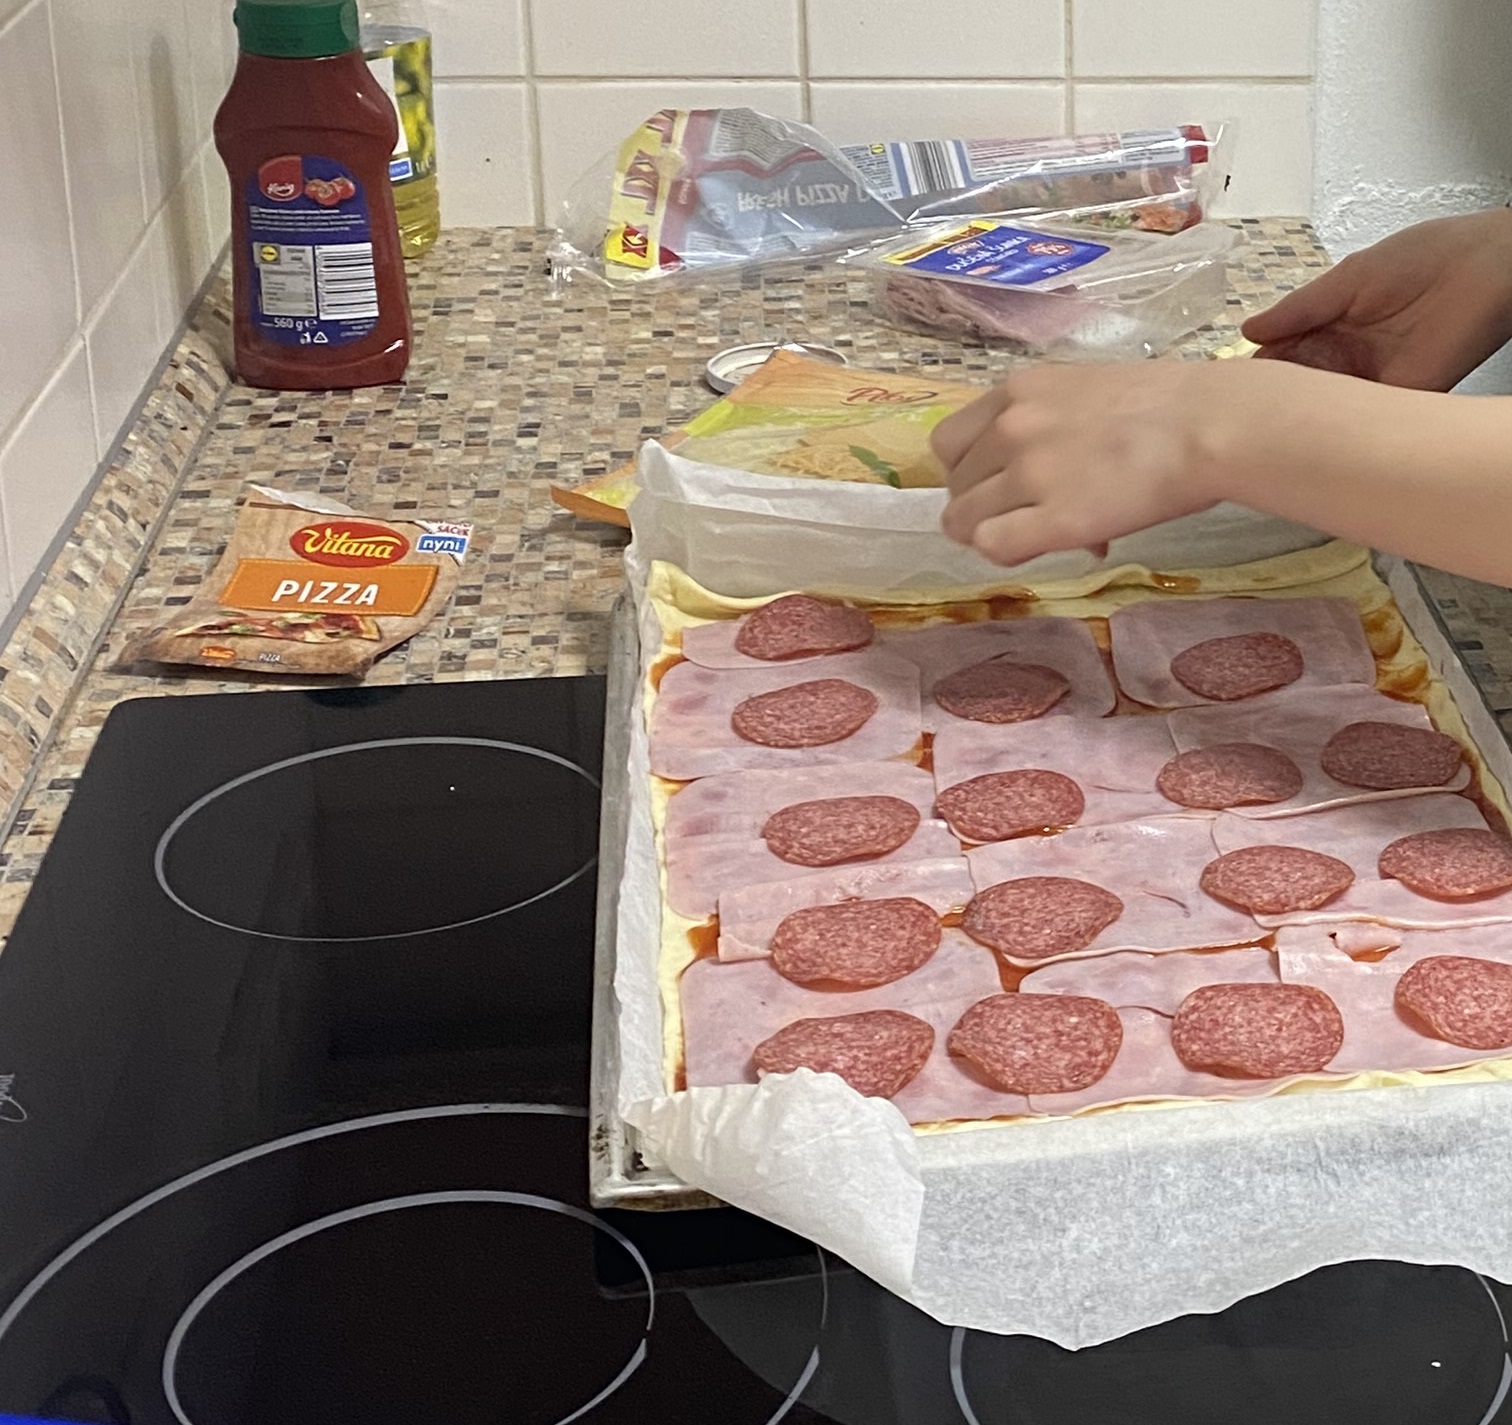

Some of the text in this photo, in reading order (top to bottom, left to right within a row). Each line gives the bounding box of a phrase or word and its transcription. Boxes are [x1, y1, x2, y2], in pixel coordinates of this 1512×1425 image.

[273, 317, 293, 329] 560
[300, 527, 402, 560] Vitana
[271, 579, 379, 606] PIZZA
